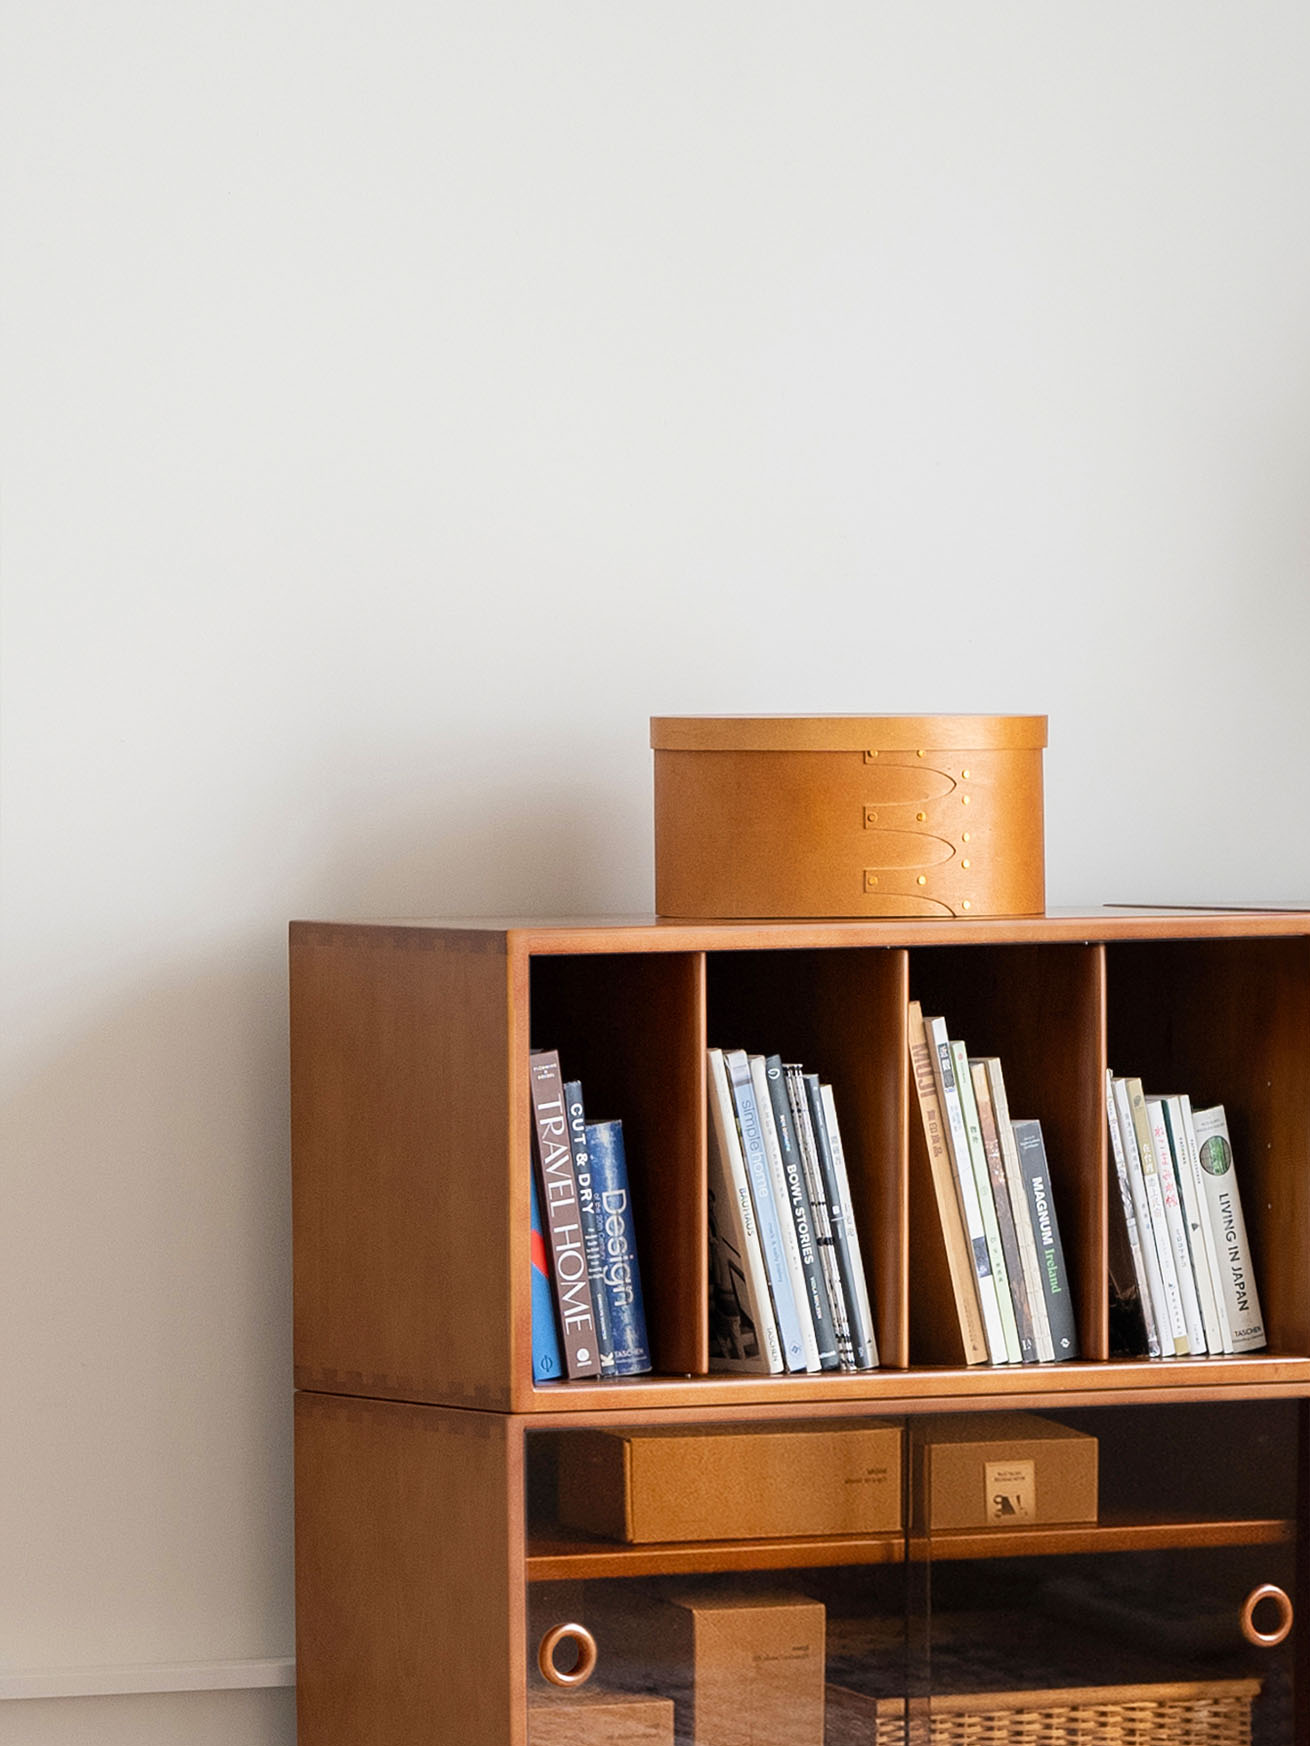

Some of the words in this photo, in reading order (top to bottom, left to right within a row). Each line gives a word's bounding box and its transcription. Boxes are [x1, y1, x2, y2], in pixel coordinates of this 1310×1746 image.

[912, 1042, 937, 1099] MUJI
[570, 1103, 587, 1144] CUT
[742, 1099, 762, 1151] simple
[538, 1094, 576, 1218] TRAVEL
[575, 1152, 589, 1167] &
[751, 1151, 769, 1199] home
[578, 1173, 595, 1214] DRY
[739, 1187, 756, 1237] BAUHAUS
[787, 1164, 802, 1206] BOWL
[796, 1208, 815, 1265] STORIES
[1219, 1193, 1237, 1243] LIVING
[601, 1189, 635, 1307] Design
[1032, 1175, 1054, 1246] MAGNUM
[1045, 1249, 1062, 1294] Ireland
[1228, 1245, 1241, 1263] IN
[553, 1223, 593, 1336] HOME
[1231, 1267, 1250, 1312] JAPAN
